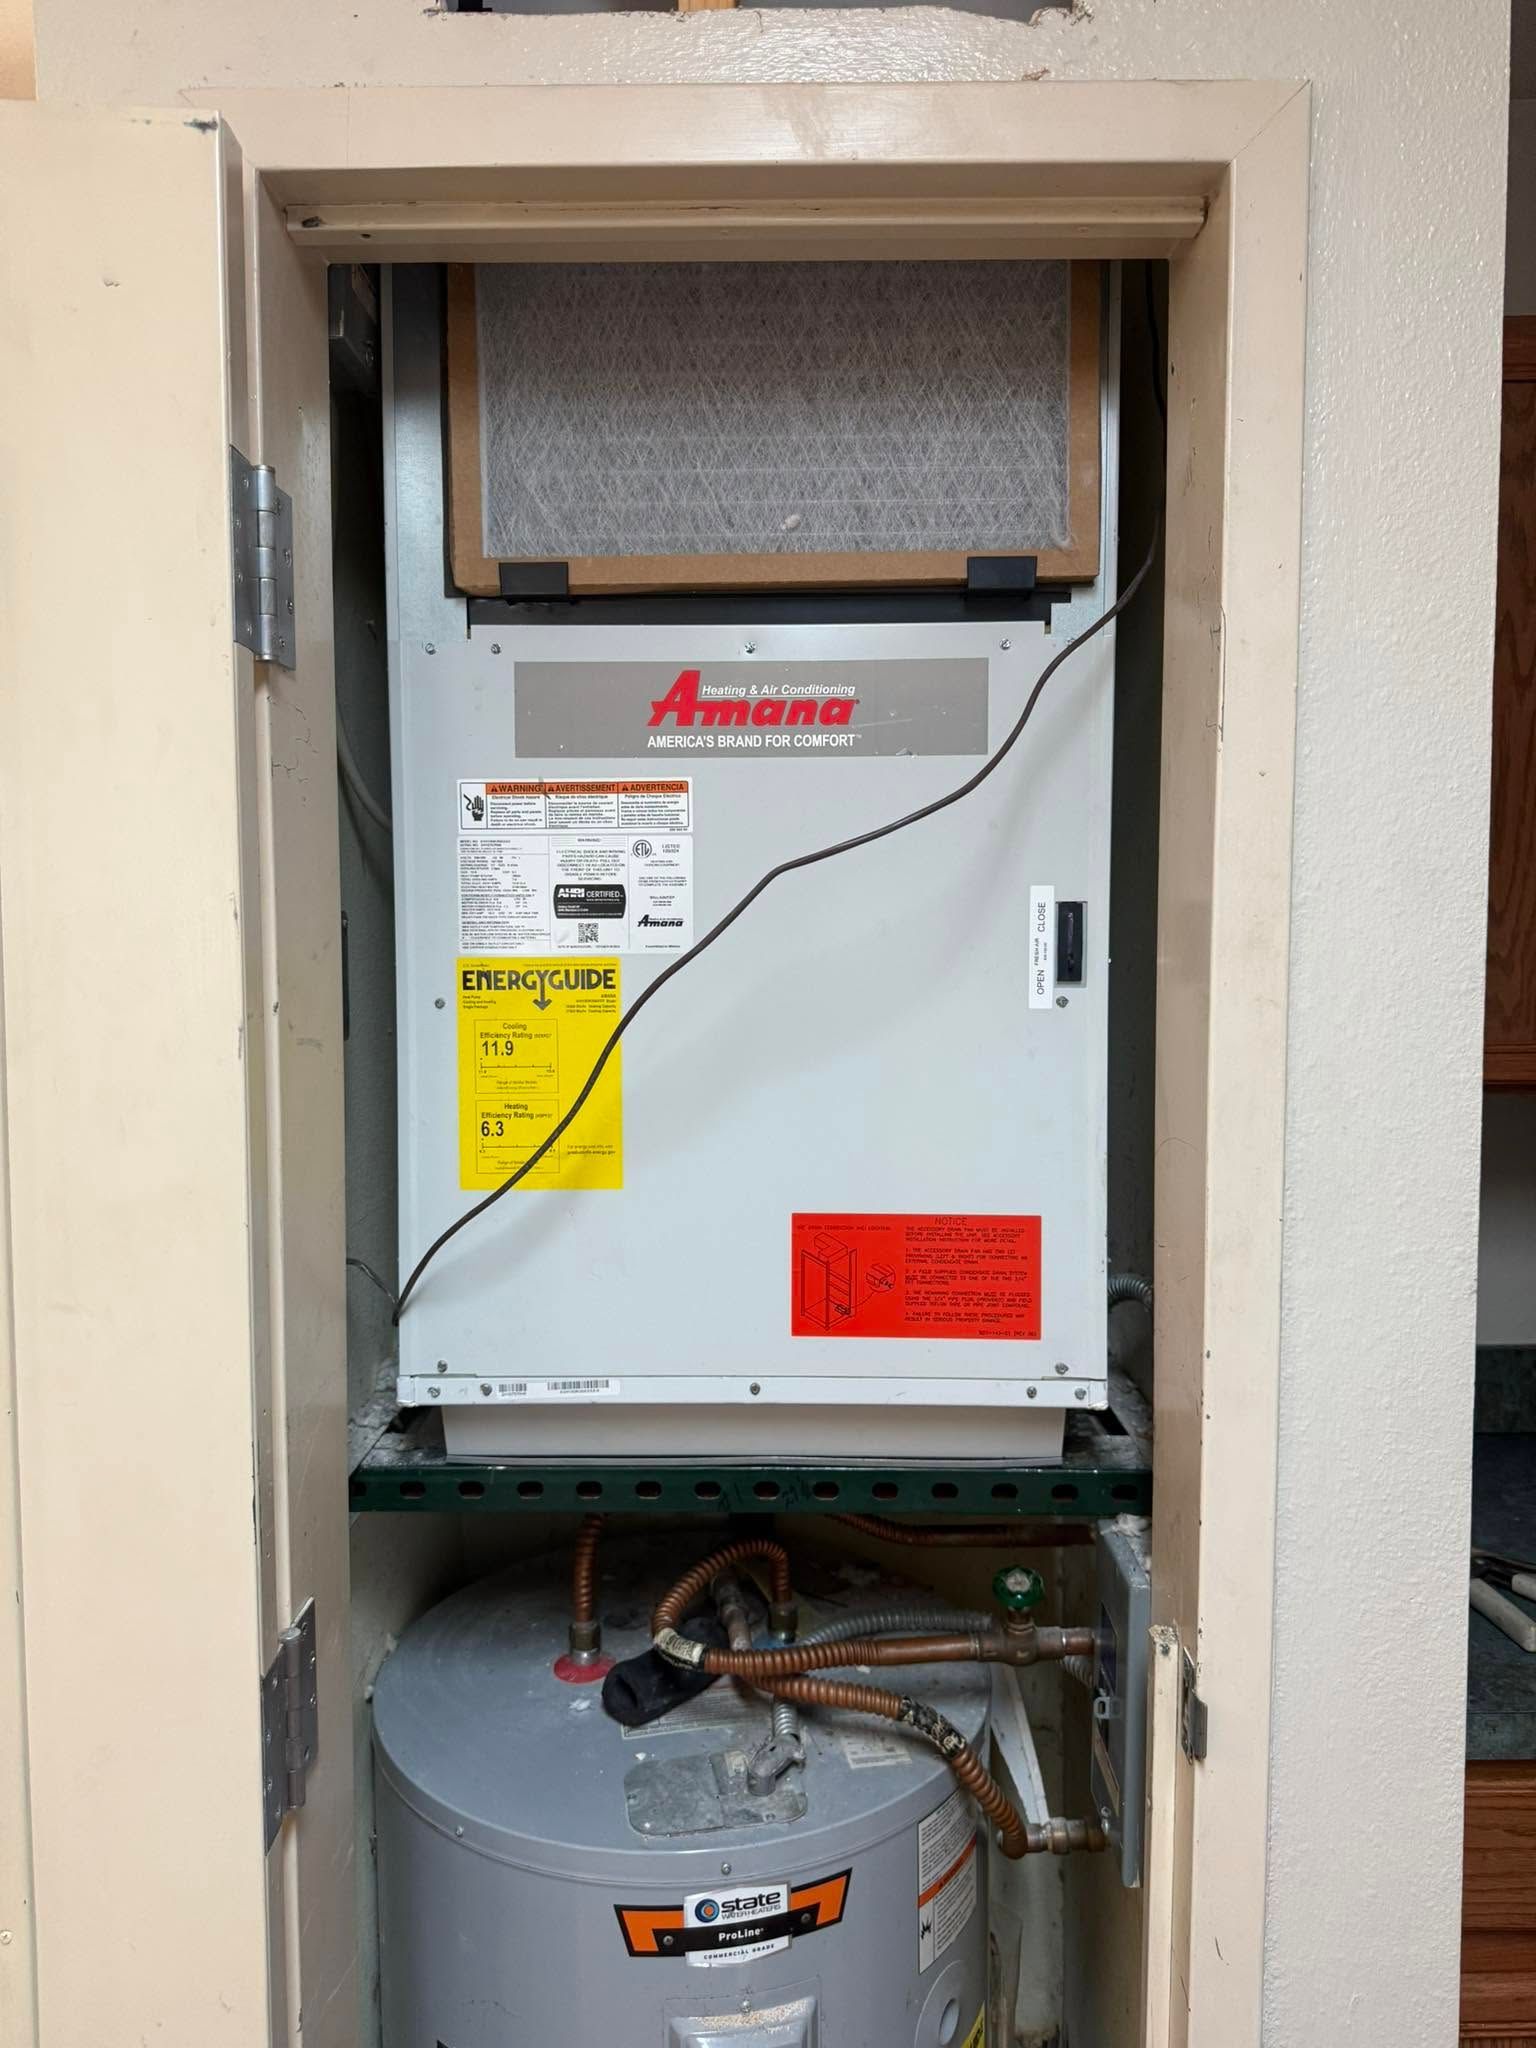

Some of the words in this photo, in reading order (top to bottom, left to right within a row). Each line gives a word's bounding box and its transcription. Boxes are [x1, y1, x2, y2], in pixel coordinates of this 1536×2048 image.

[647, 670, 857, 727] Amana
[702, 685, 746, 698] Heating
[750, 685, 758, 696] &
[761, 685, 778, 695] Air
[781, 684, 856, 697] Conditioning
[647, 735, 714, 748] AMERICA'S
[717, 735, 762, 748] BRAND
[765, 735, 790, 747] FOR
[499, 784, 541, 792] WARNING
[556, 784, 616, 792] AVERTISSEMENT
[630, 783, 684, 791] ADVERTENCIA
[637, 914, 684, 927] Amana
[1037, 902, 1046, 932] CLOSE
[462, 969, 616, 991] ENERGYGUIDE
[1036, 969, 1045, 995] OPEN
[502, 1022, 527, 1030] Cooling
[482, 1040, 514, 1056] 11.9
[504, 1103, 528, 1111] Heating
[481, 1121, 504, 1137] 6.3
[934, 1217, 967, 1226] NOTICE
[721, 1892, 781, 1913] state
[721, 1910, 748, 1920] WATER
[748, 1904, 781, 1916] HEATERS
[703, 1949, 749, 1960] COMMERCIAL
[752, 1943, 775, 1953] GRADE
